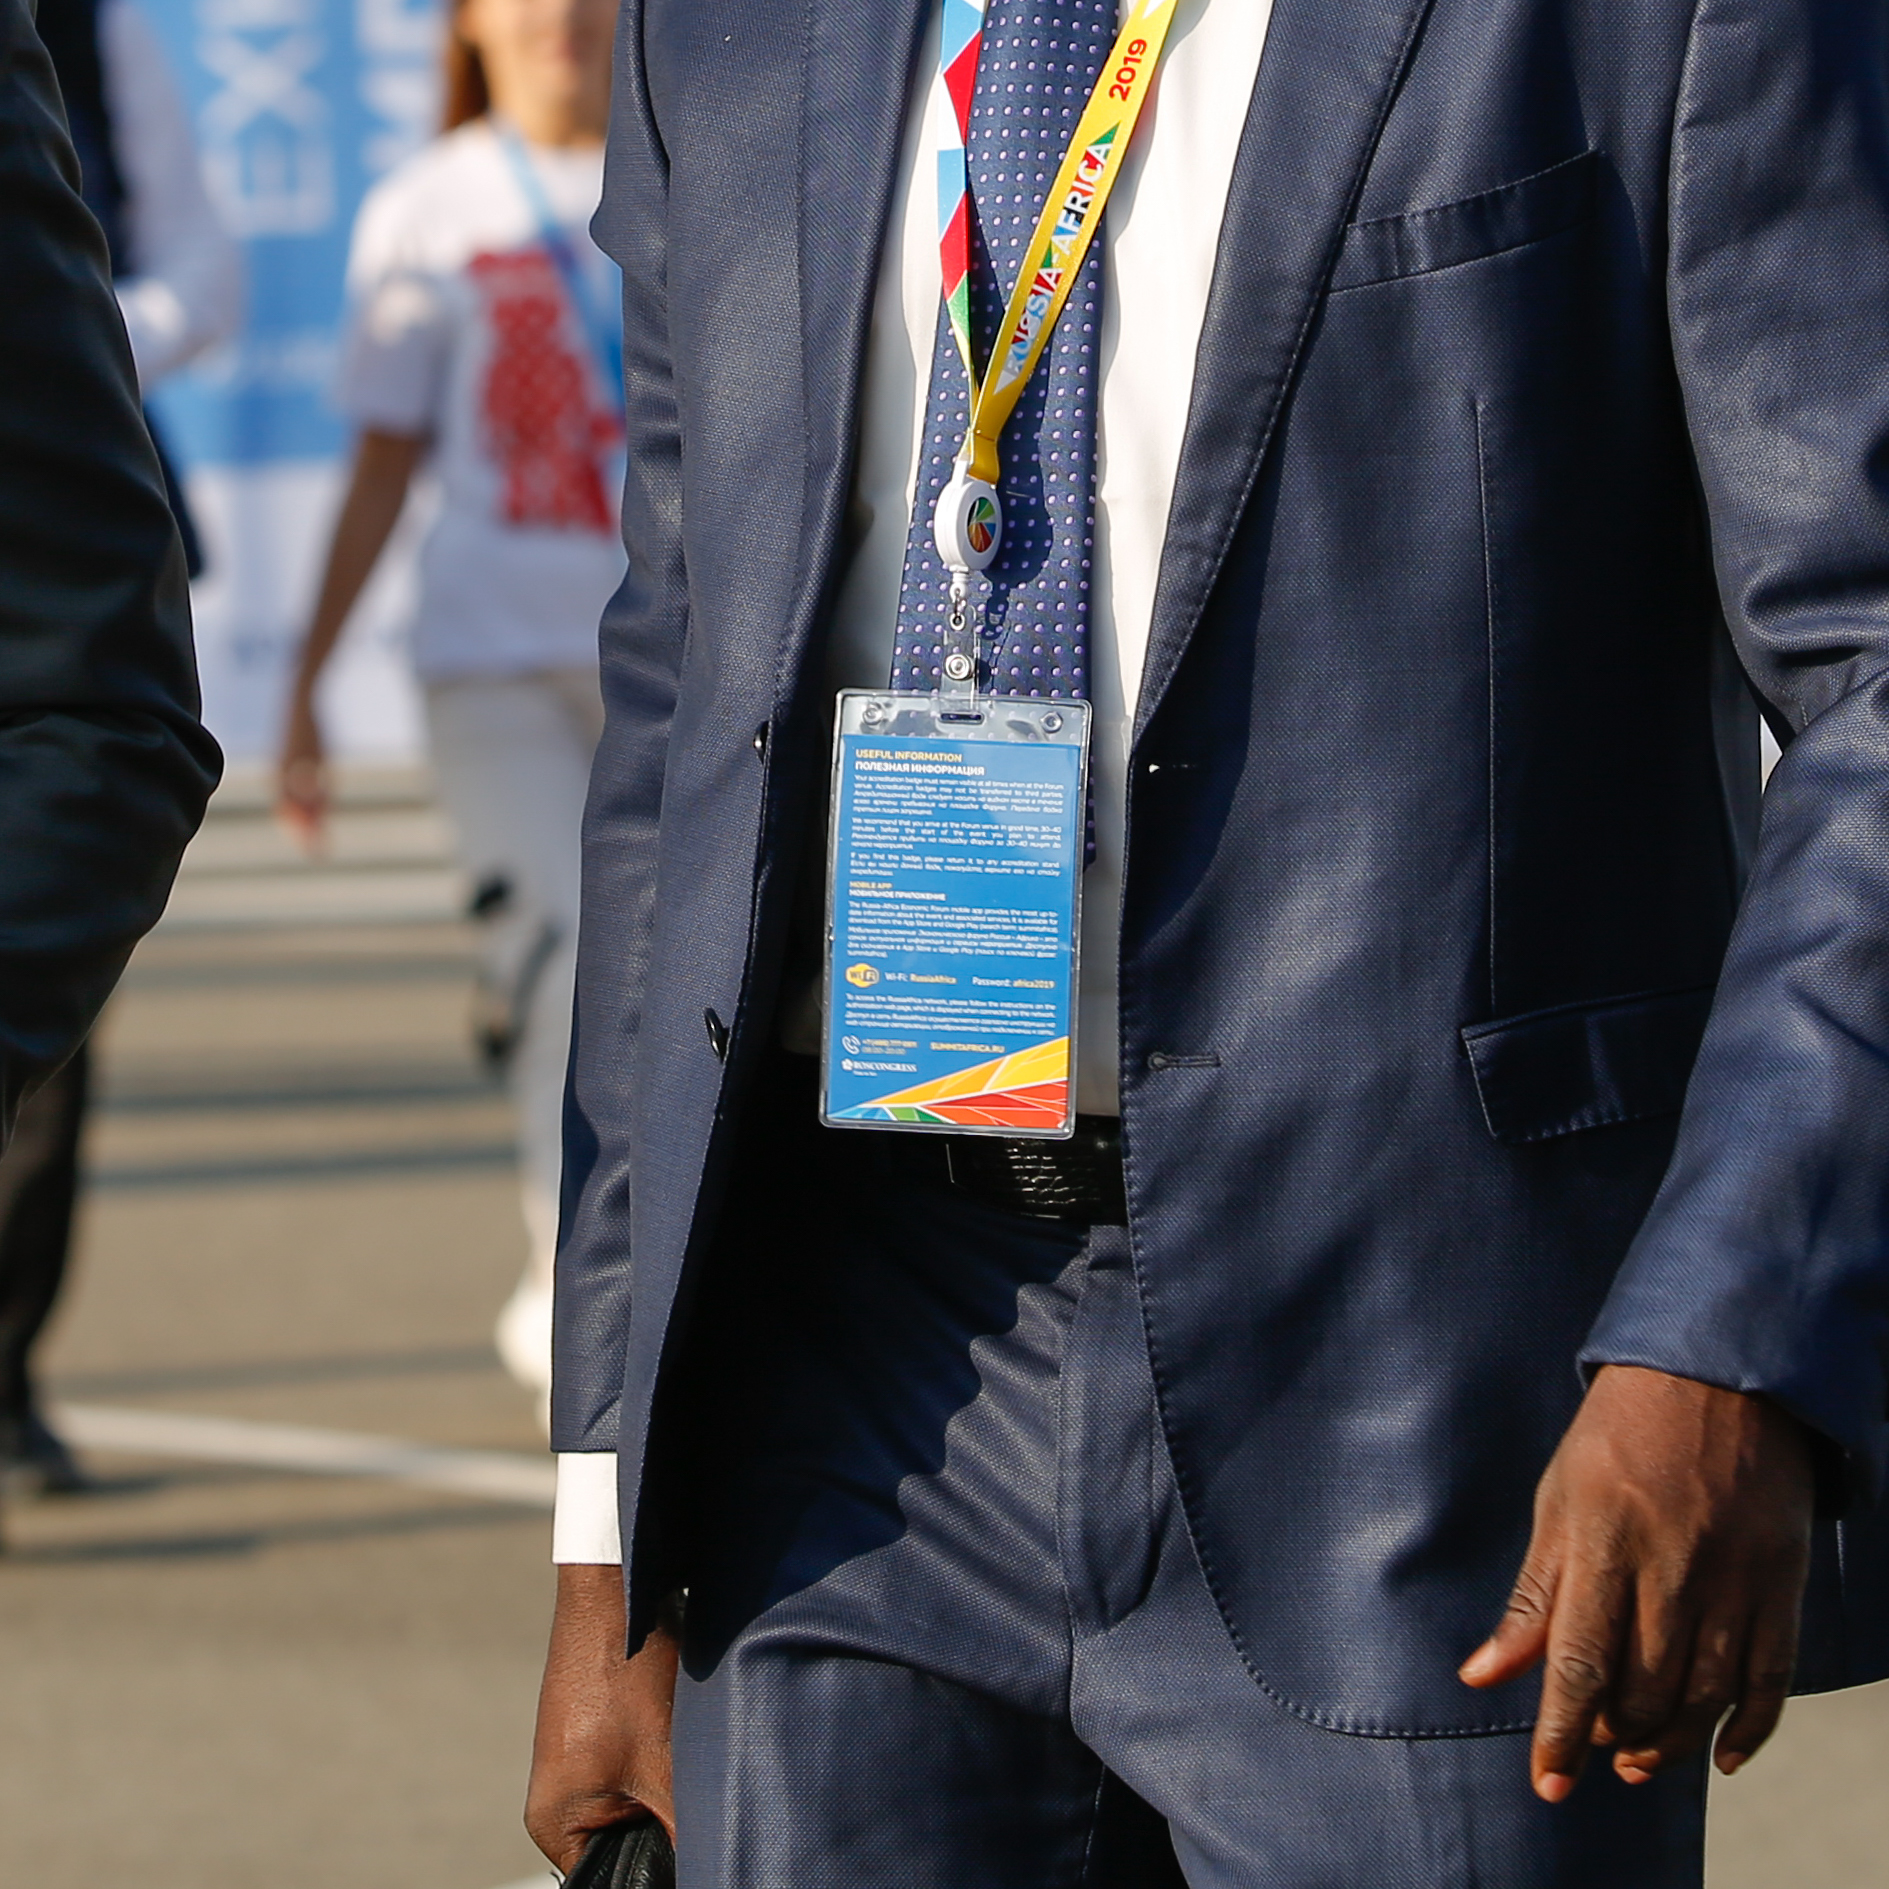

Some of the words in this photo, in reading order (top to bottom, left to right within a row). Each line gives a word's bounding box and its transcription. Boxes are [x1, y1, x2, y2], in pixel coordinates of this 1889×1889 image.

[1108, 38, 1148, 102] 2019
[1005, 142, 1114, 374] RUSSIA-AFRICA
[854, 760, 909, 772] ПОЛЕЗНАЯ
[910, 763, 985, 776] ИНФОРМАЦИЯ
[855, 748, 893, 759] USEFUL
[894, 750, 962, 762] INFORMATION
